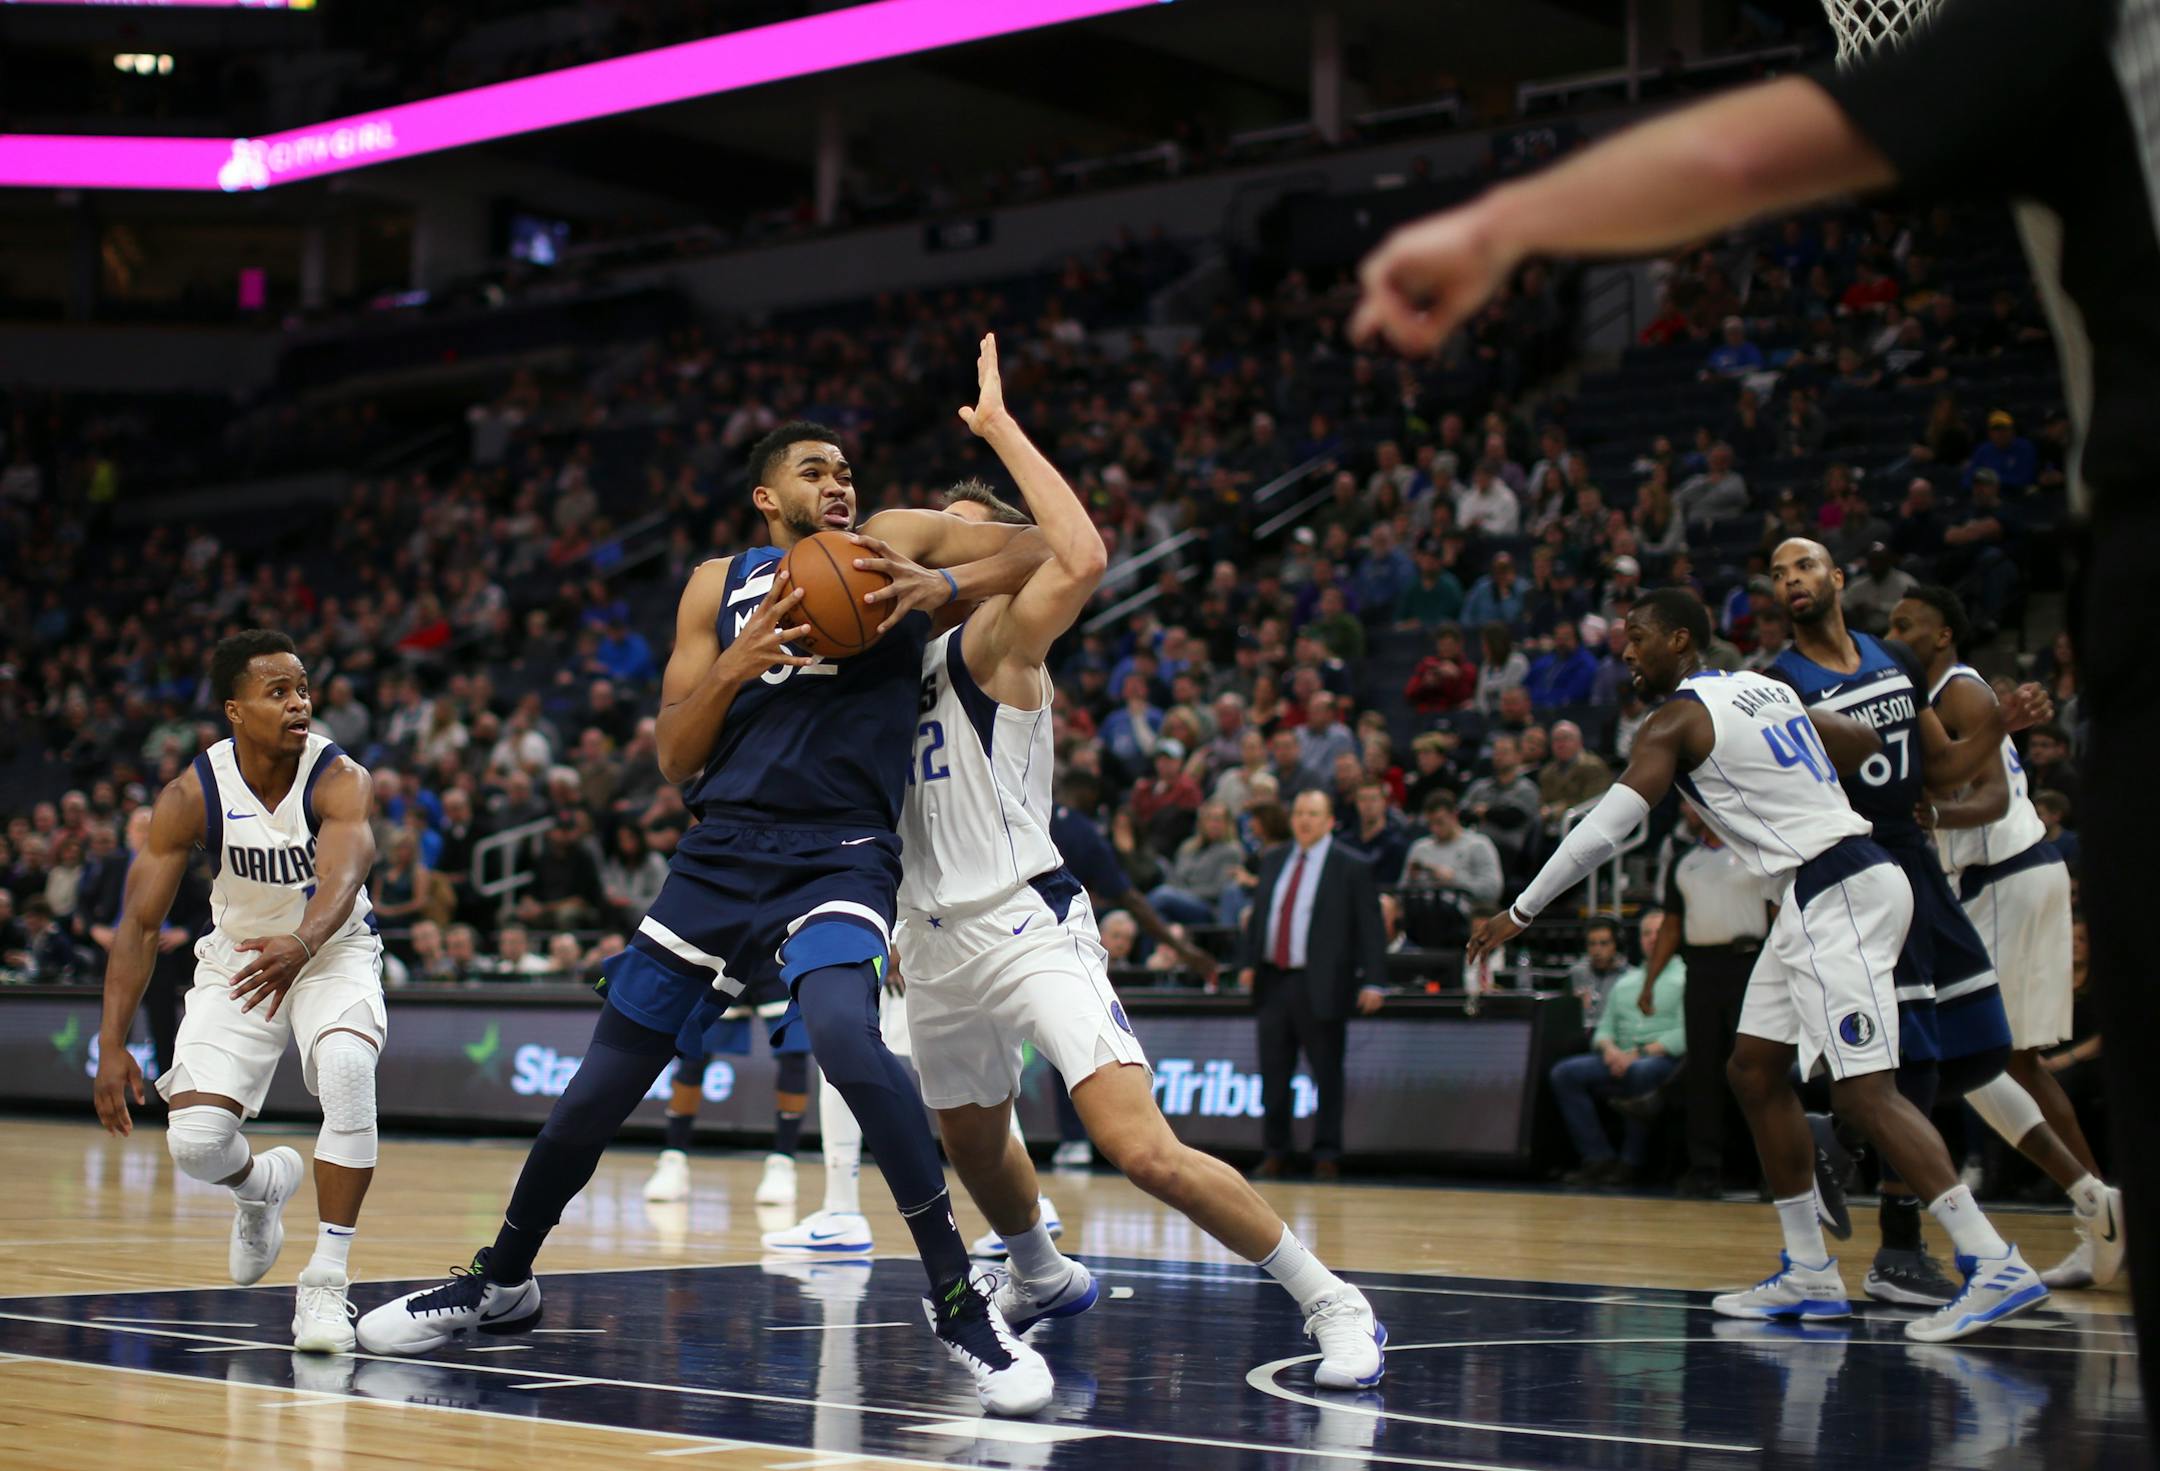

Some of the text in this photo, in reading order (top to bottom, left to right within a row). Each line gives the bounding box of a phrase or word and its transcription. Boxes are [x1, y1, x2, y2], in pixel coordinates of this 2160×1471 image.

[1731, 687, 1790, 719] BARNES
[908, 720, 951, 786] 2
[1761, 714, 1837, 783] 40
